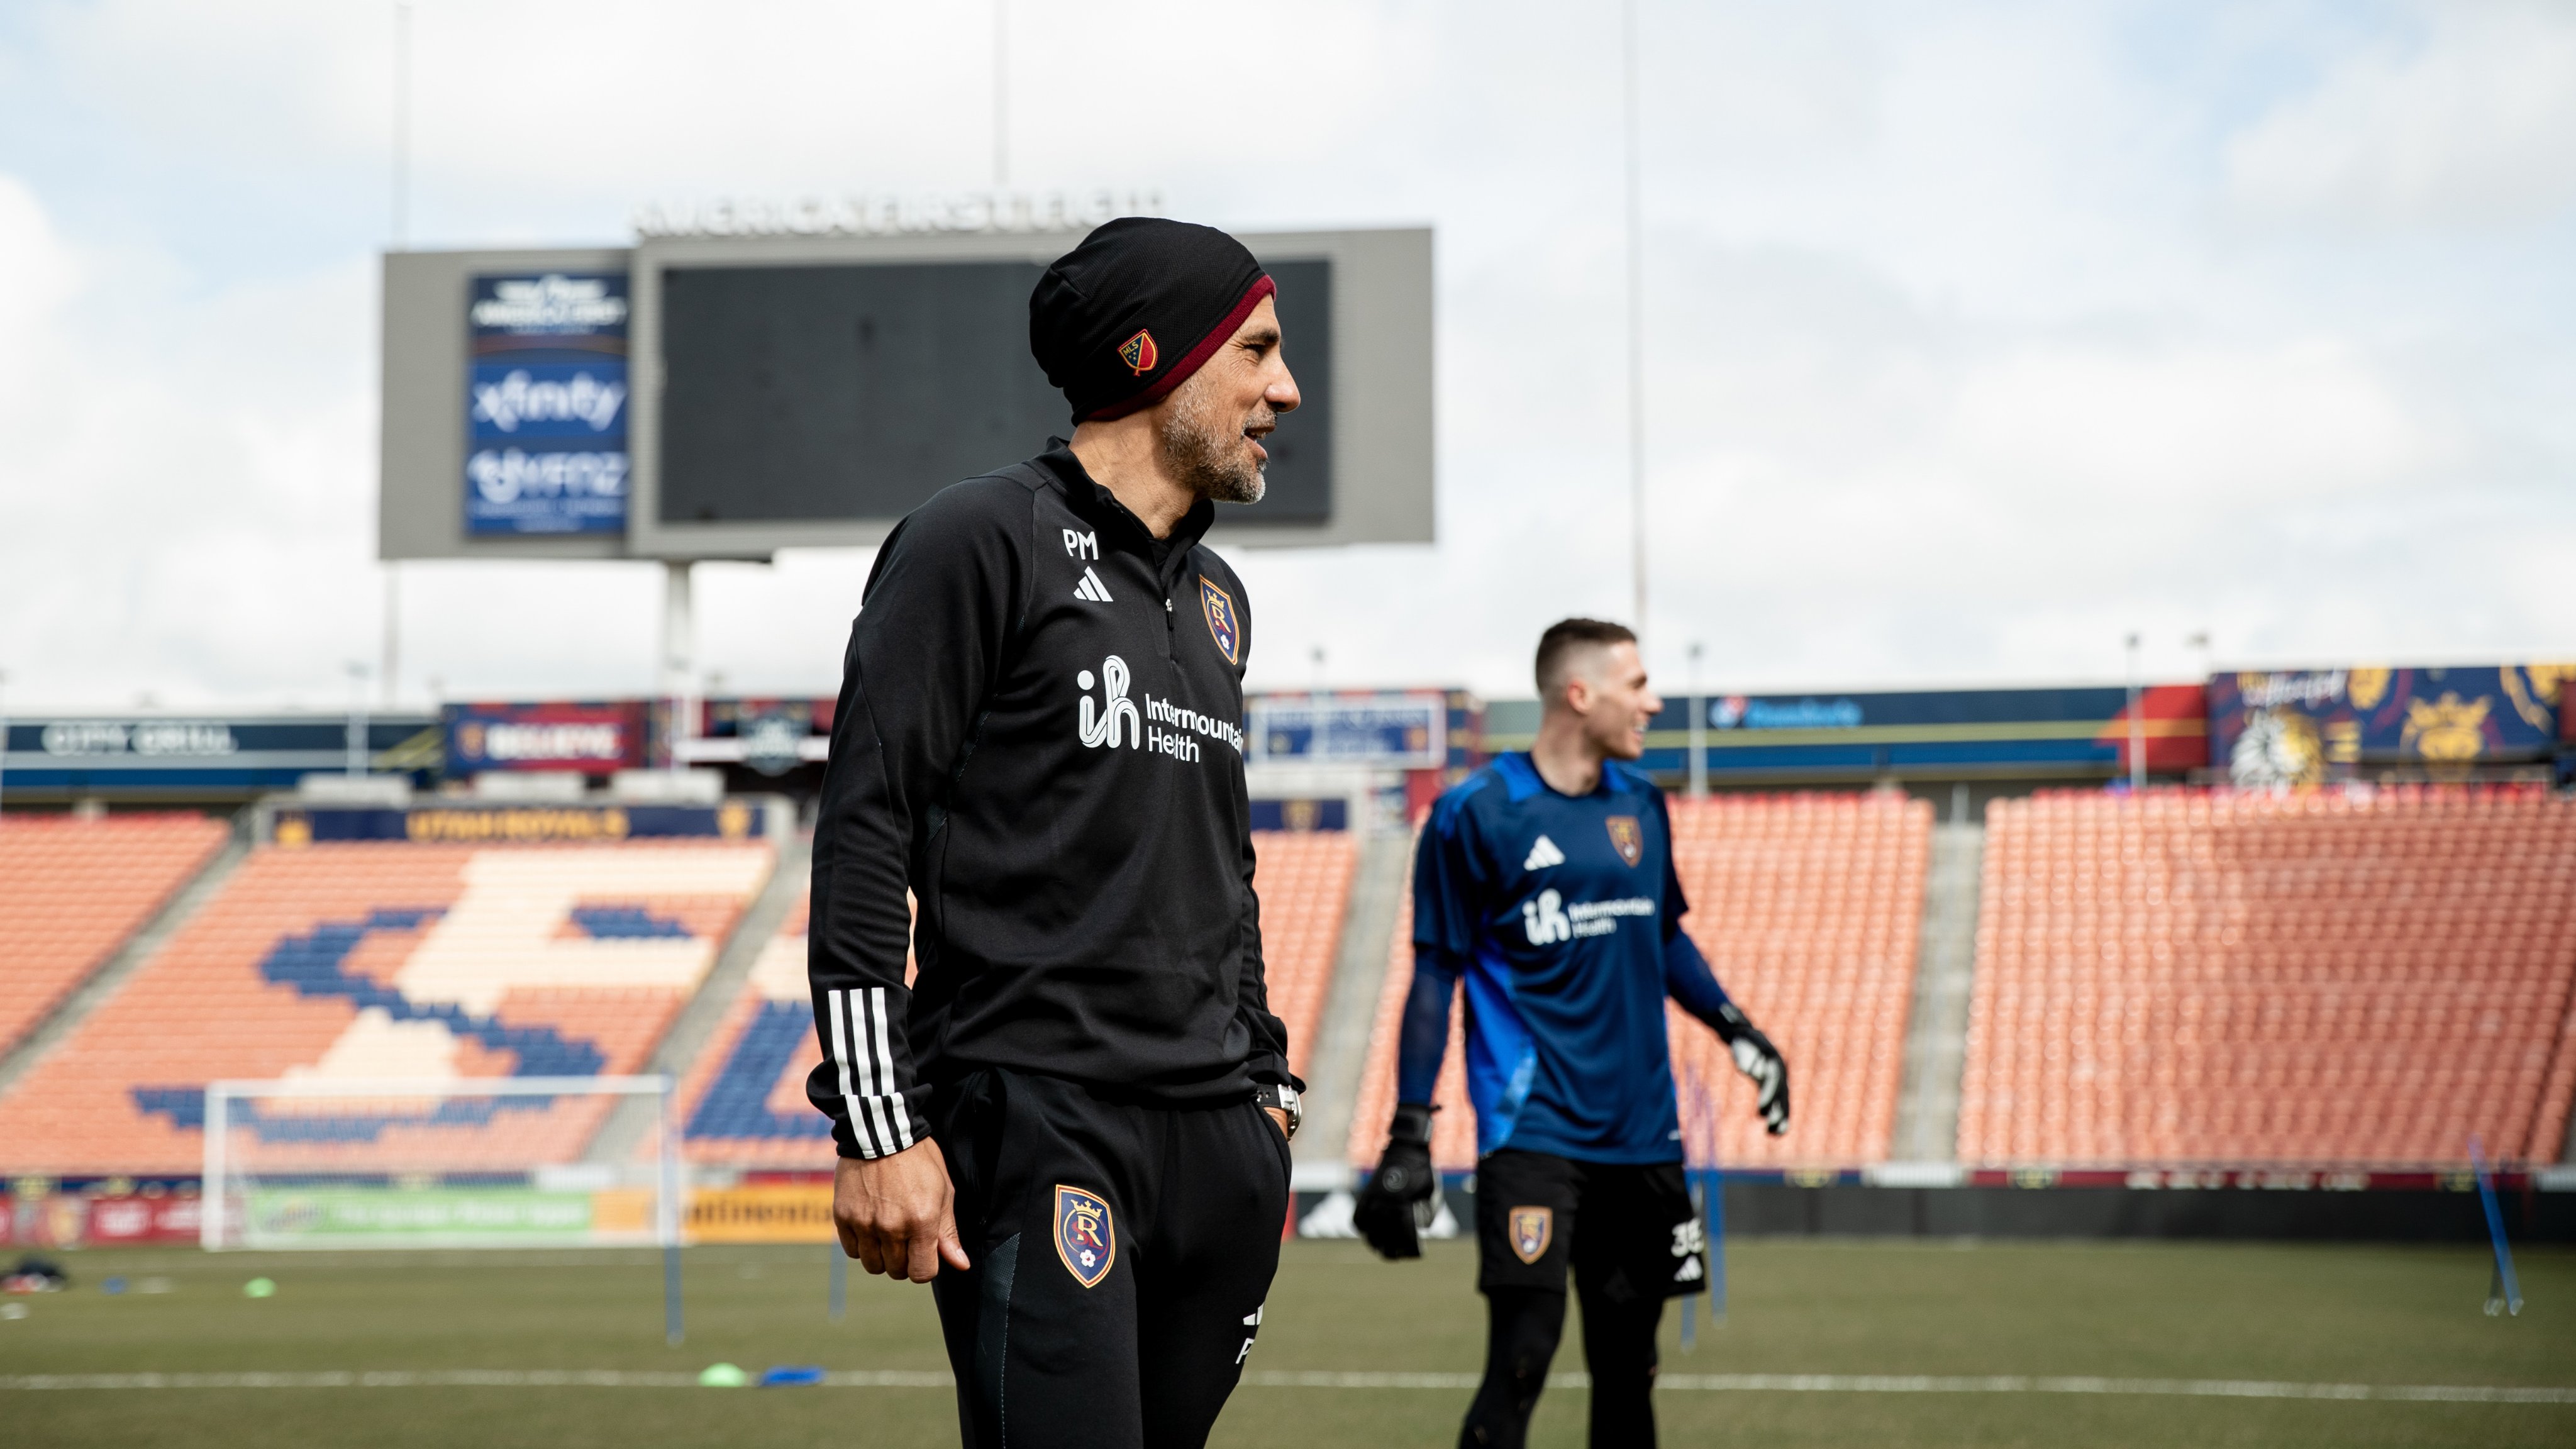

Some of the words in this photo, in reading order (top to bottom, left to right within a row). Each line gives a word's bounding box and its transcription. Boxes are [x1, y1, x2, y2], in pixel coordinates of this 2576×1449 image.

[1123, 341, 1139, 356] MLS
[1062, 528, 1099, 560] PM
[1148, 725, 1199, 763] Helth
[1235, 1338, 1255, 1363] P
